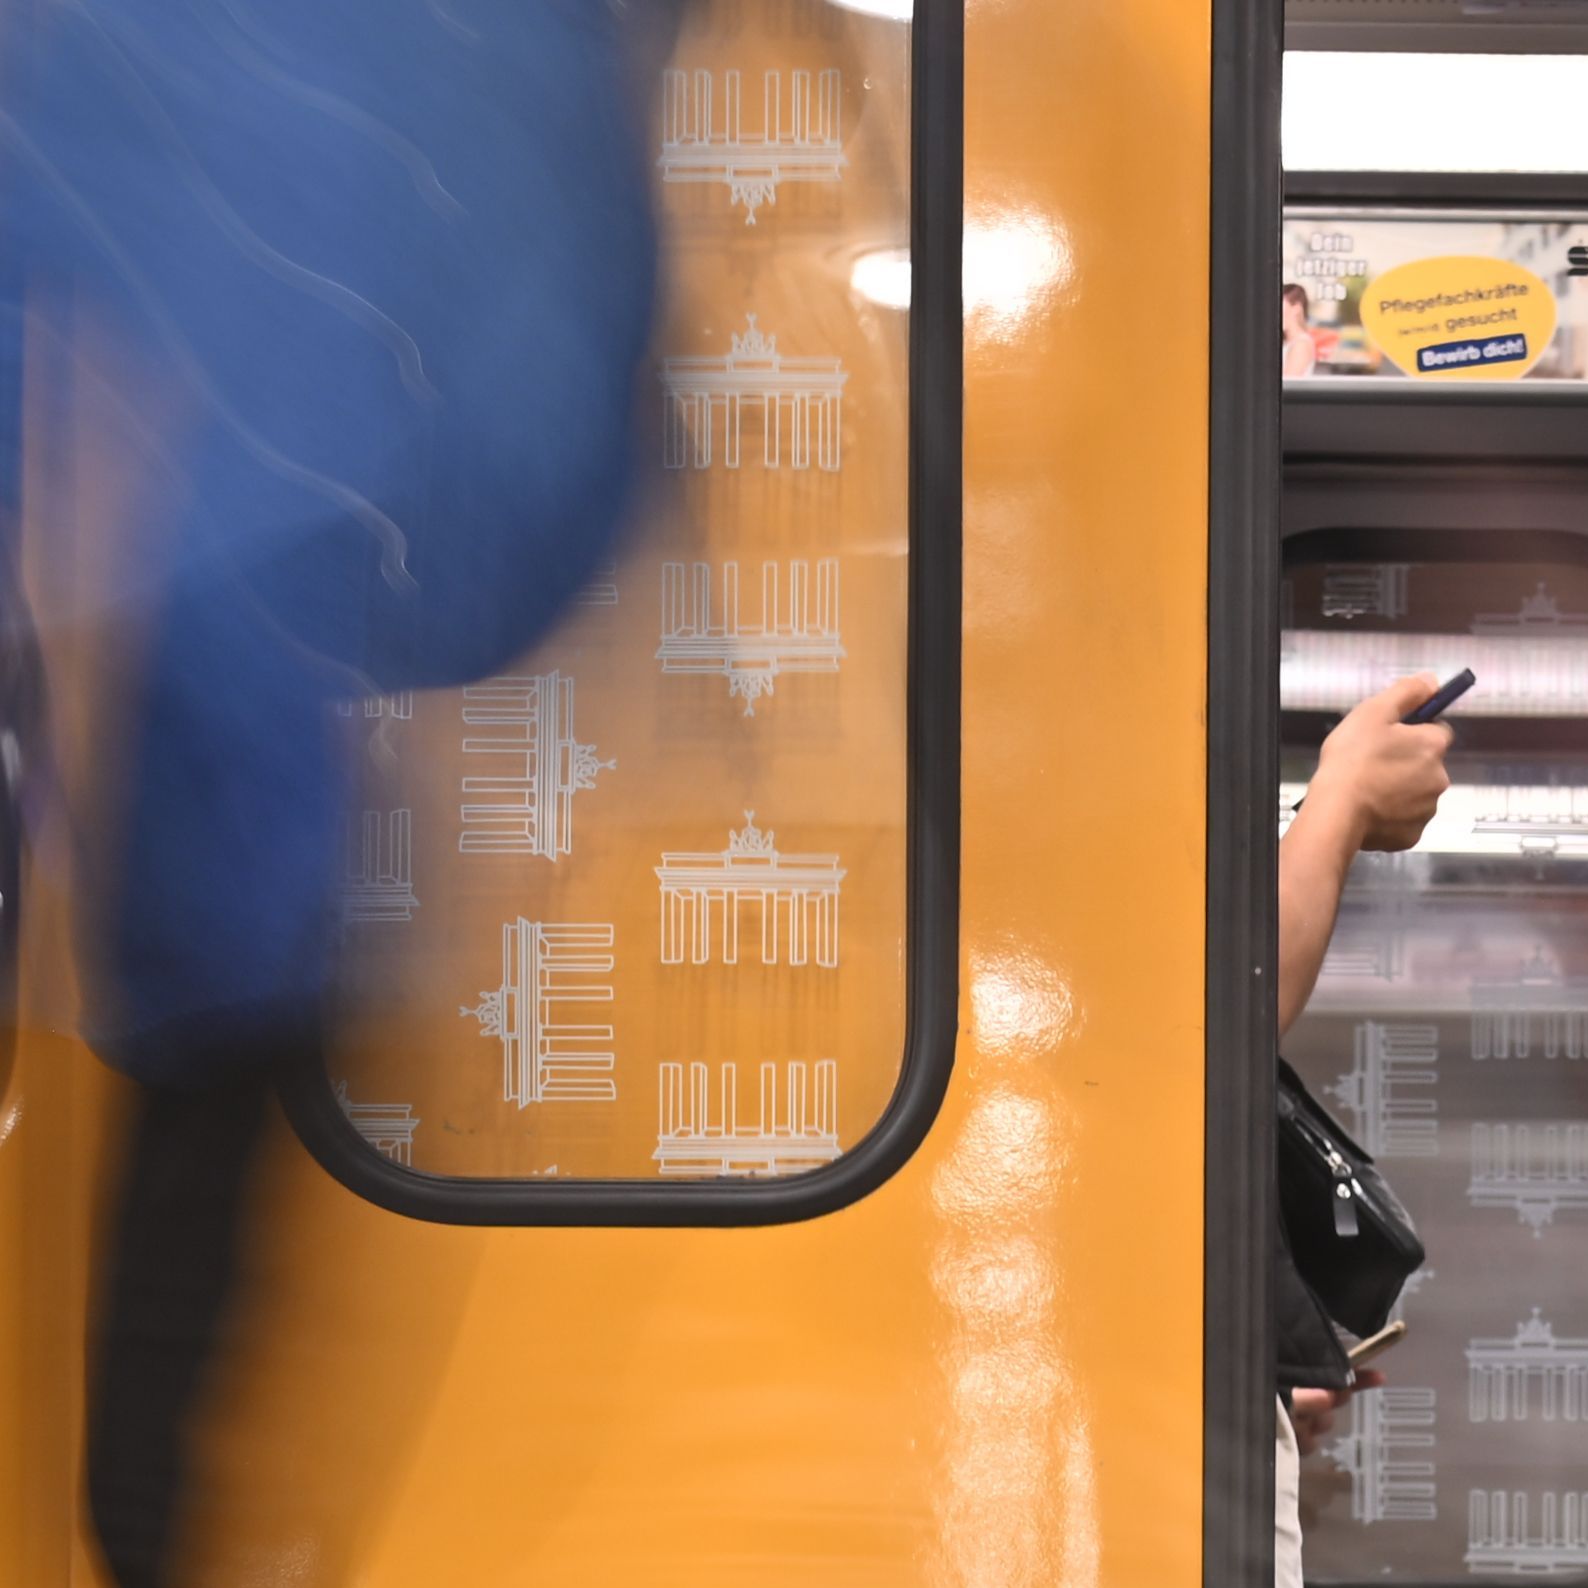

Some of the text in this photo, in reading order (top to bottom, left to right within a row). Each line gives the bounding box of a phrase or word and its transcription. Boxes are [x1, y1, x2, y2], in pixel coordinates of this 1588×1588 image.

[1379, 284, 1530, 316] Pflegefachkräfte
[1446, 308, 1518, 333] gesucht
[1421, 338, 1525, 367] Bewirb dich!
